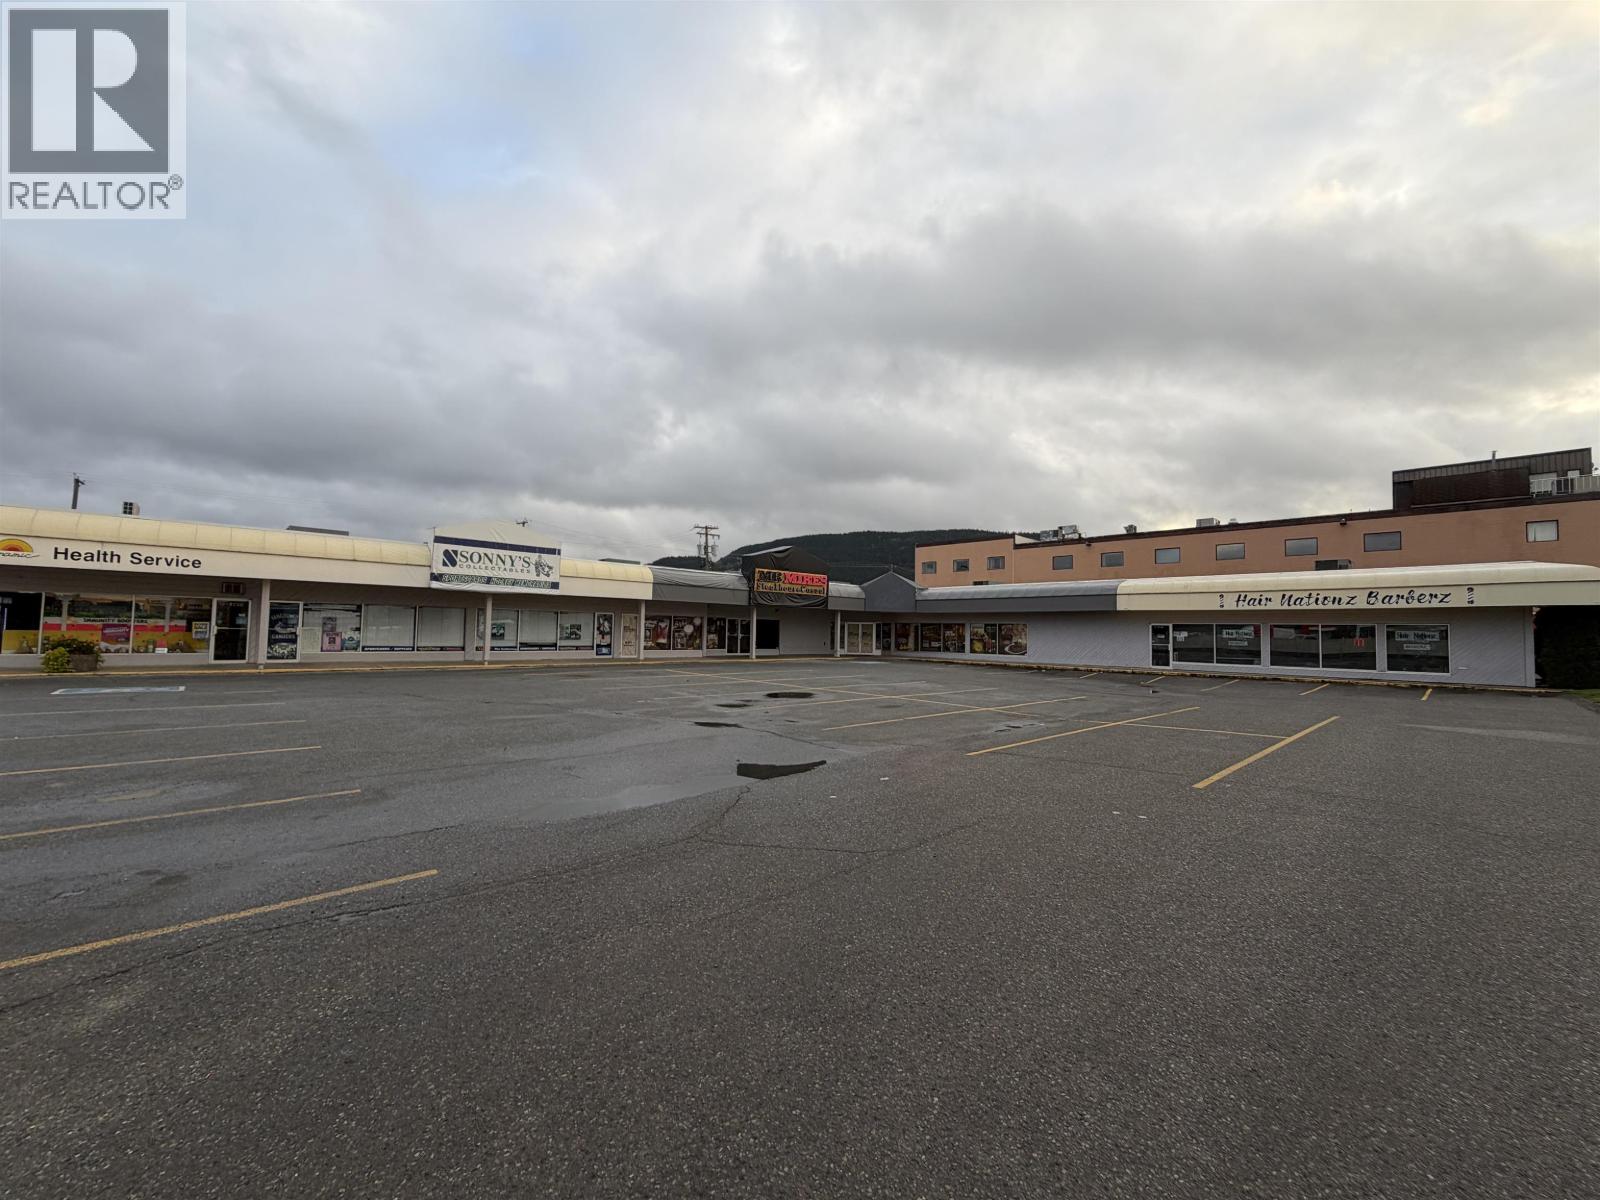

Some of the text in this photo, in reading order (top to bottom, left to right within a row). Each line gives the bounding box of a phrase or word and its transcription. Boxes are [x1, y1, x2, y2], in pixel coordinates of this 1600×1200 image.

[53, 547, 201, 569] Health Service
[459, 551, 531, 568] SONNY'S
[458, 564, 531, 574] COLLECTABLES
[1235, 593, 1273, 607] Hair
[1366, 590, 1452, 605] Barberz
